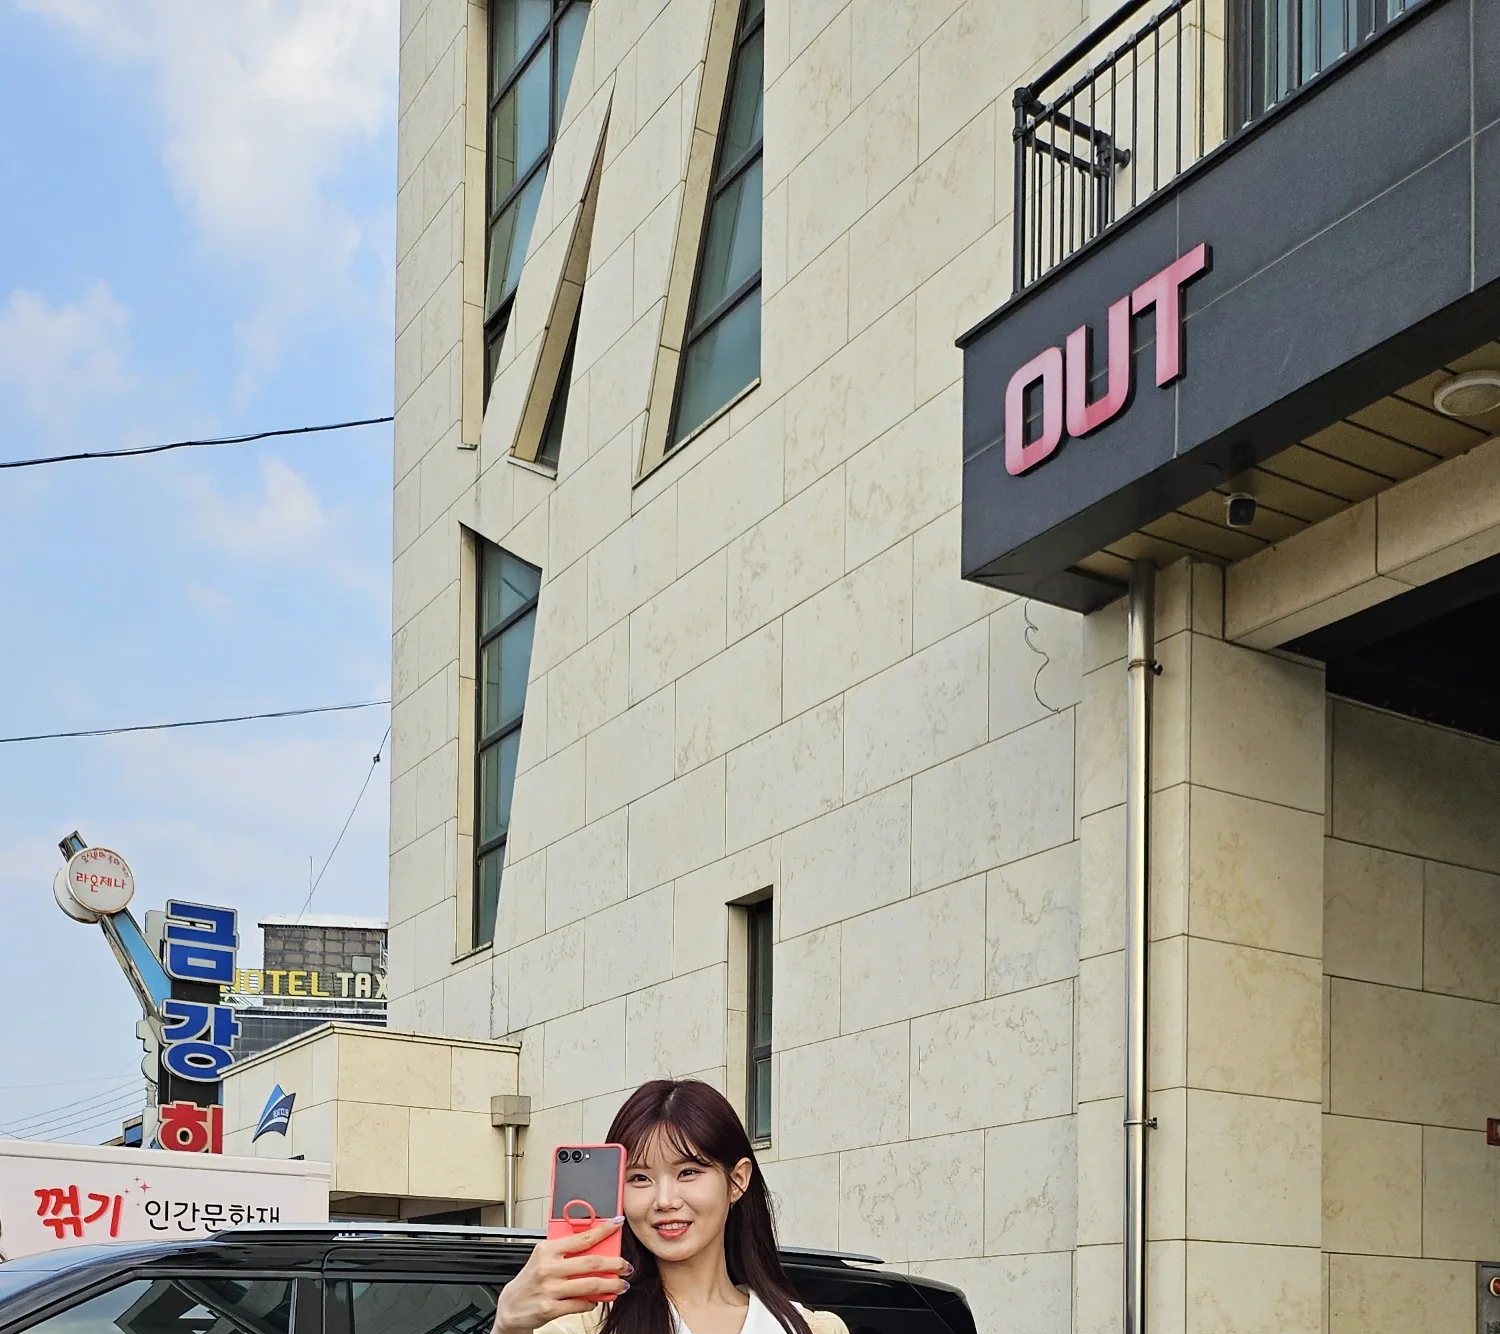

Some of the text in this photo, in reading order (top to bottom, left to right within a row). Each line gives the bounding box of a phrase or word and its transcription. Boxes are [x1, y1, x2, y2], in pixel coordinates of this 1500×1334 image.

[1004, 242, 1212, 477] OUT
[76, 871, 127, 893] 라온제나
[34, 1184, 124, 1240] 꺾기
